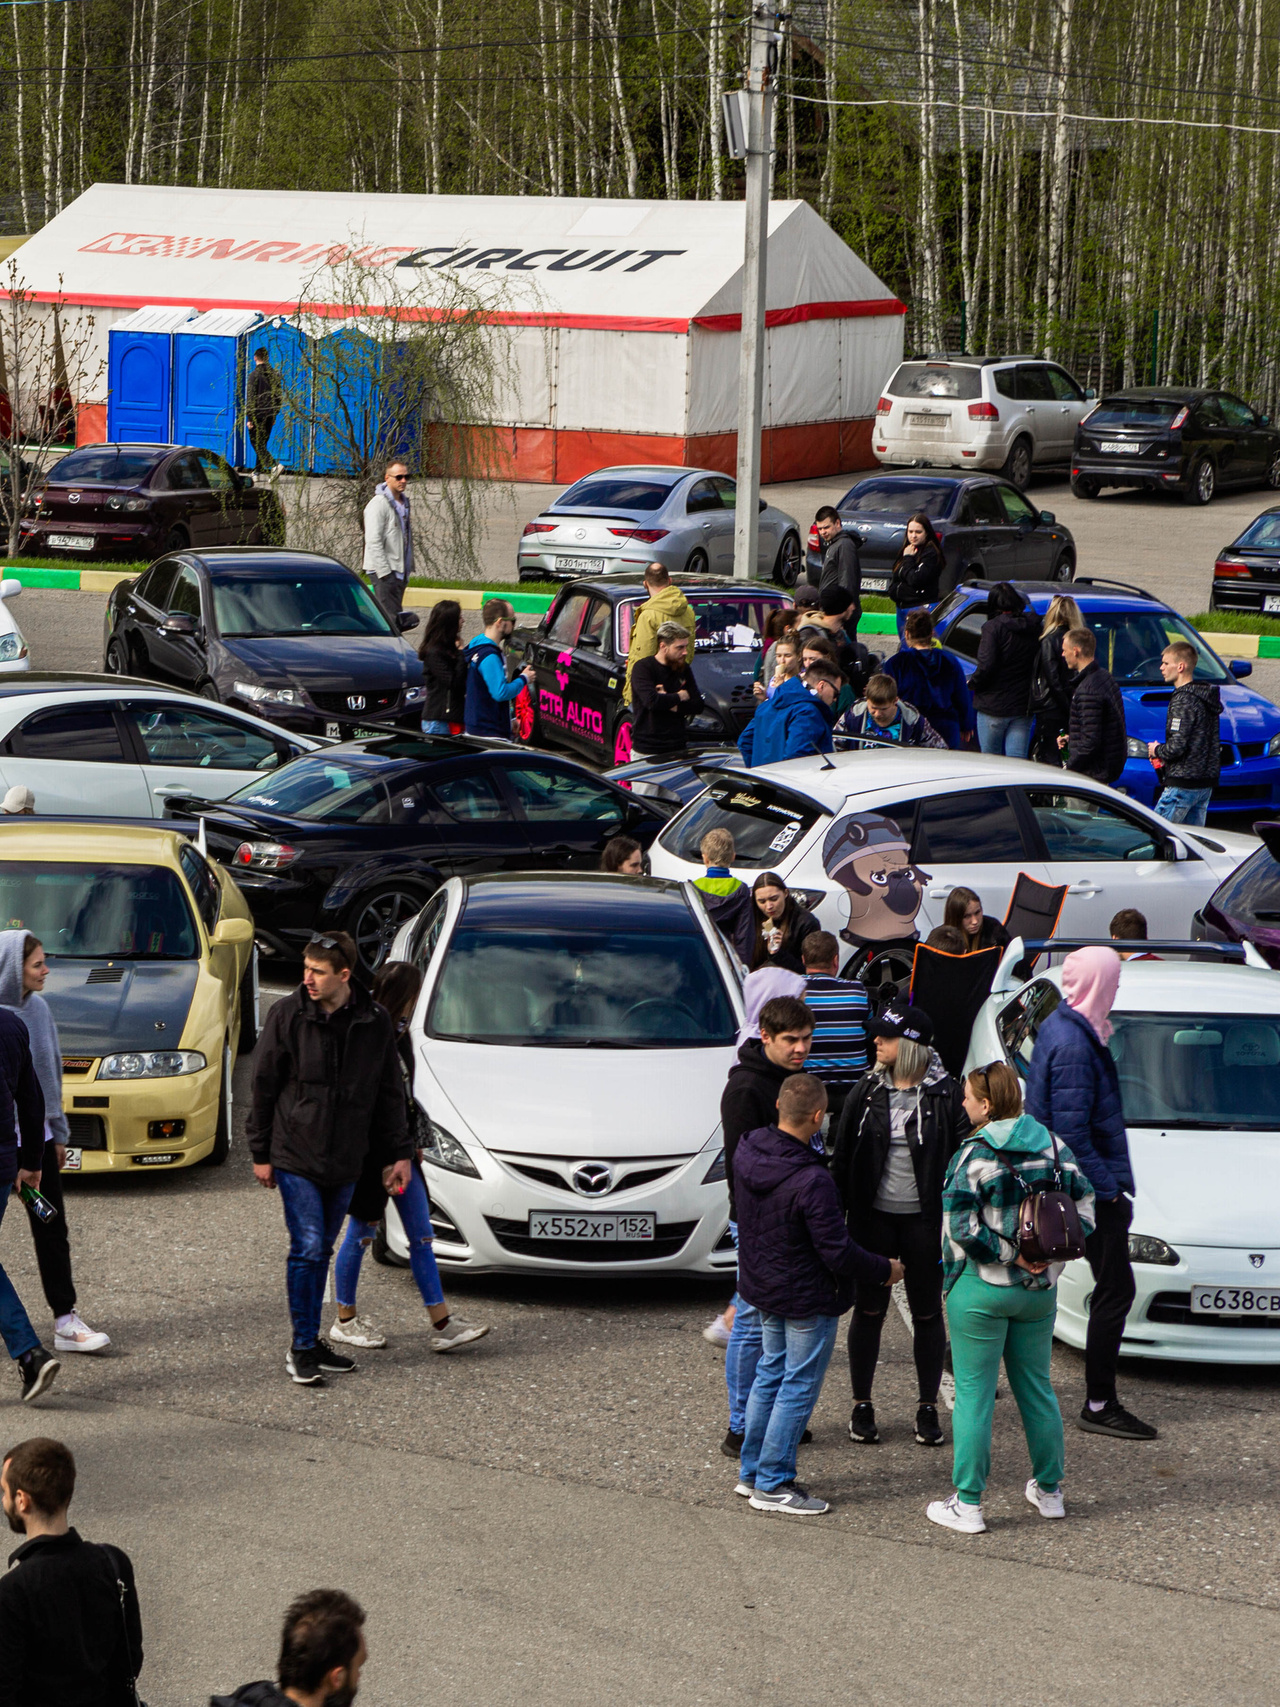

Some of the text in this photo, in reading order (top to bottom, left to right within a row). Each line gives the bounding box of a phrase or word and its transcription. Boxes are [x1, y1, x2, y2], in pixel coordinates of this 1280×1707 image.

[540, 688, 603, 734] CTR AUTO
[537, 1218, 648, 1238] Х552ХР 152
[1199, 1289, 1280, 1311] С638СВ
